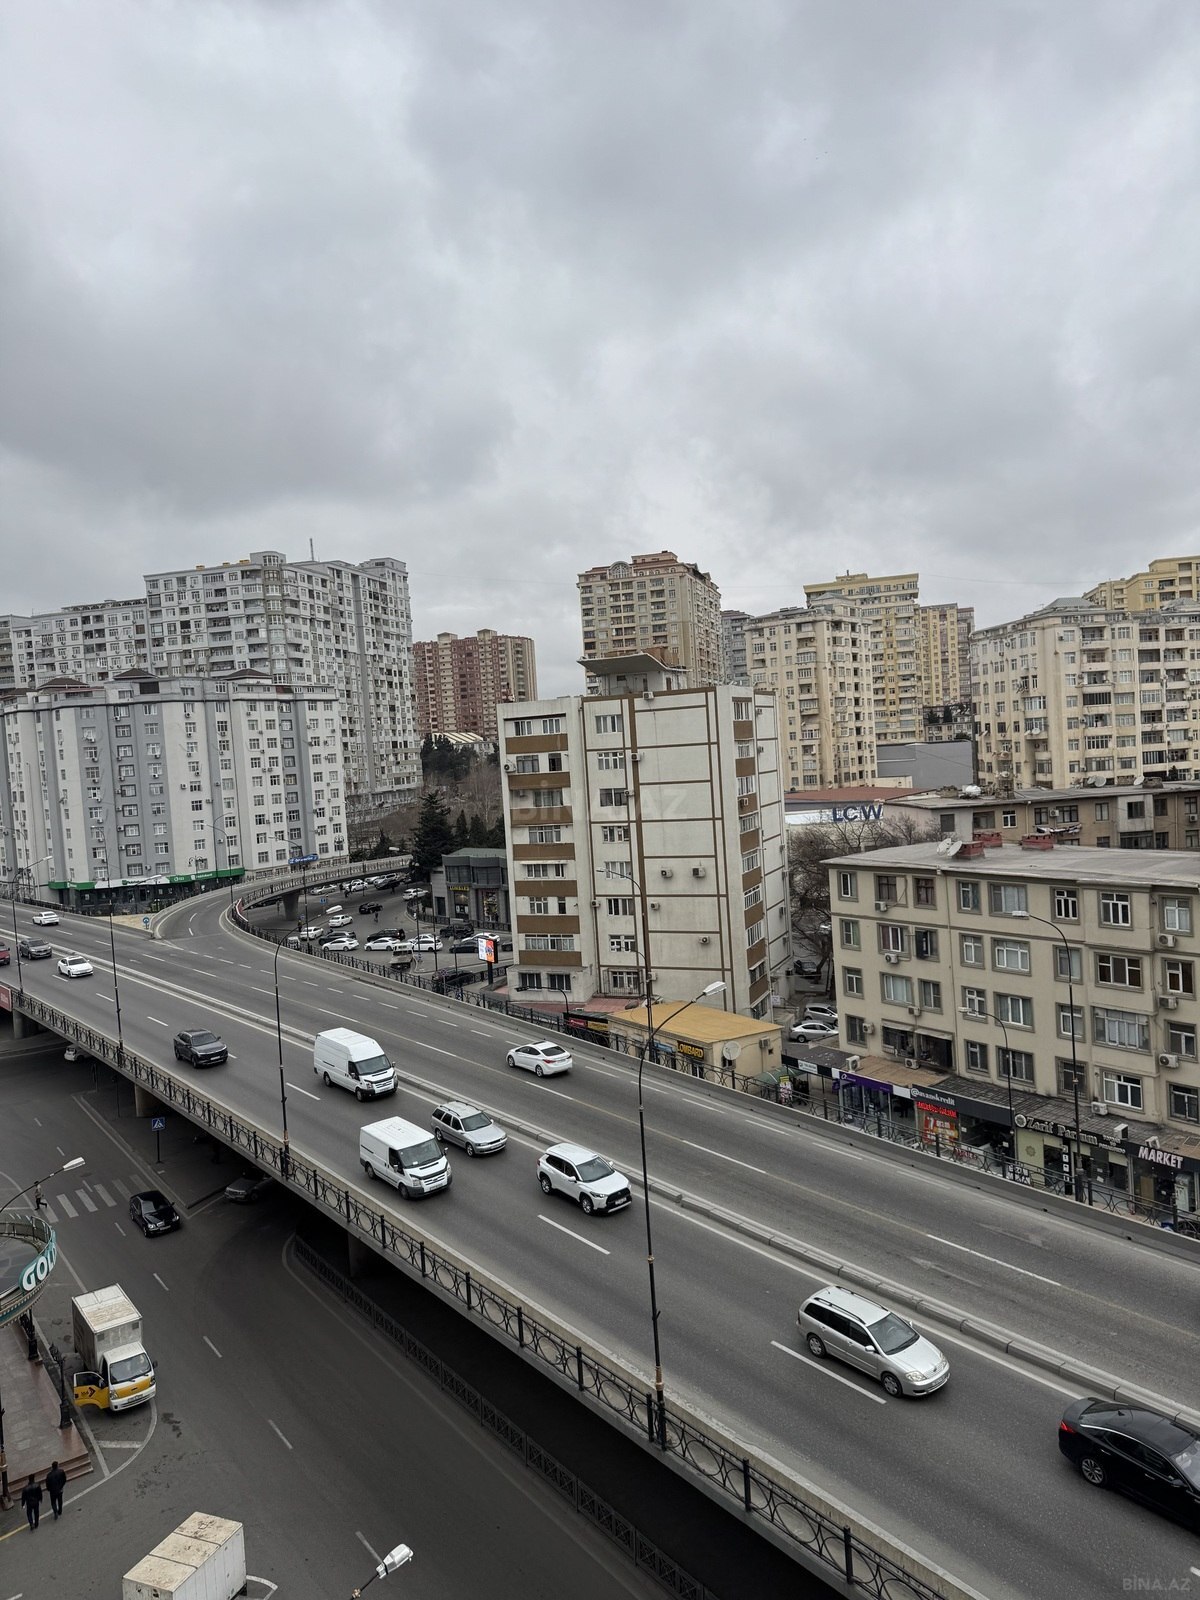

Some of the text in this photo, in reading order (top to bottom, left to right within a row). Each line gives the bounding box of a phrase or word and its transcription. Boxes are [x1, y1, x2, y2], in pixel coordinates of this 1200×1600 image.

[831, 803, 884, 823] LCW
[677, 1042, 704, 1058] LOMBARD
[1026, 1117, 1098, 1146] Zarif Parum
[1138, 1145, 1184, 1169] MARKET
